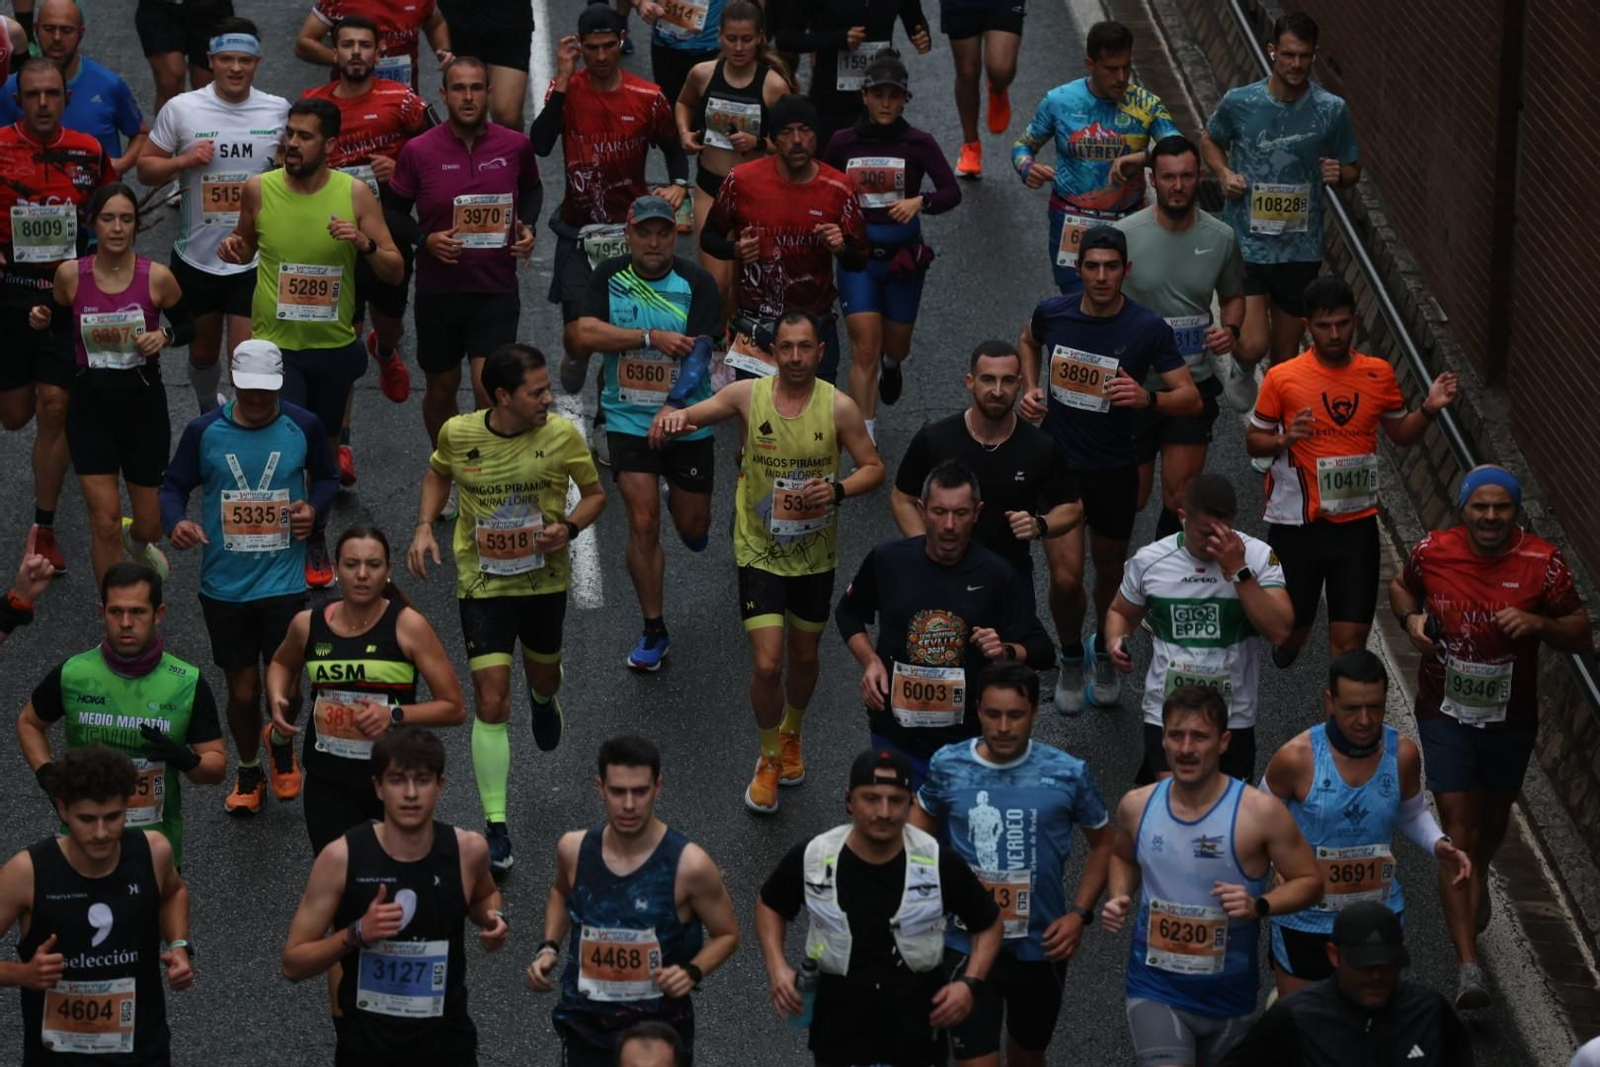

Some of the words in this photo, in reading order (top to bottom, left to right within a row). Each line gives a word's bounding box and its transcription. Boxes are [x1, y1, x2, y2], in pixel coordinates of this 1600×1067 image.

[220, 143, 252, 158] SAM
[211, 186, 242, 204] 515
[1256, 196, 1301, 214] 10828
[462, 207, 499, 225] 3970
[22, 218, 63, 238] 8009
[288, 277, 328, 297] 5289
[626, 363, 664, 382] 6360
[1059, 362, 1100, 387] 3890
[752, 454, 788, 469] AMIGOS
[465, 483, 503, 497] AMIGOS
[1323, 470, 1370, 490] 10417
[232, 506, 277, 525] 5335
[486, 531, 529, 551] 5318
[1174, 607, 1217, 621] GIOS
[1176, 622, 1217, 637] EPPO
[316, 664, 366, 682] ASM
[903, 681, 947, 702] 6003
[1453, 675, 1497, 698] 9346
[78, 695, 106, 706] HOKA
[79, 711, 113, 726] MEDIO
[117, 715, 171, 733] MARATÓN
[324, 705, 356, 726] 381
[1006, 808, 1025, 870] VERDEO
[1329, 862, 1376, 883] 3691
[1159, 918, 1208, 944] 6230
[62, 949, 139, 970] selección
[590, 947, 642, 970] 4468
[372, 958, 429, 984] 3127
[57, 998, 113, 1021] 4604
